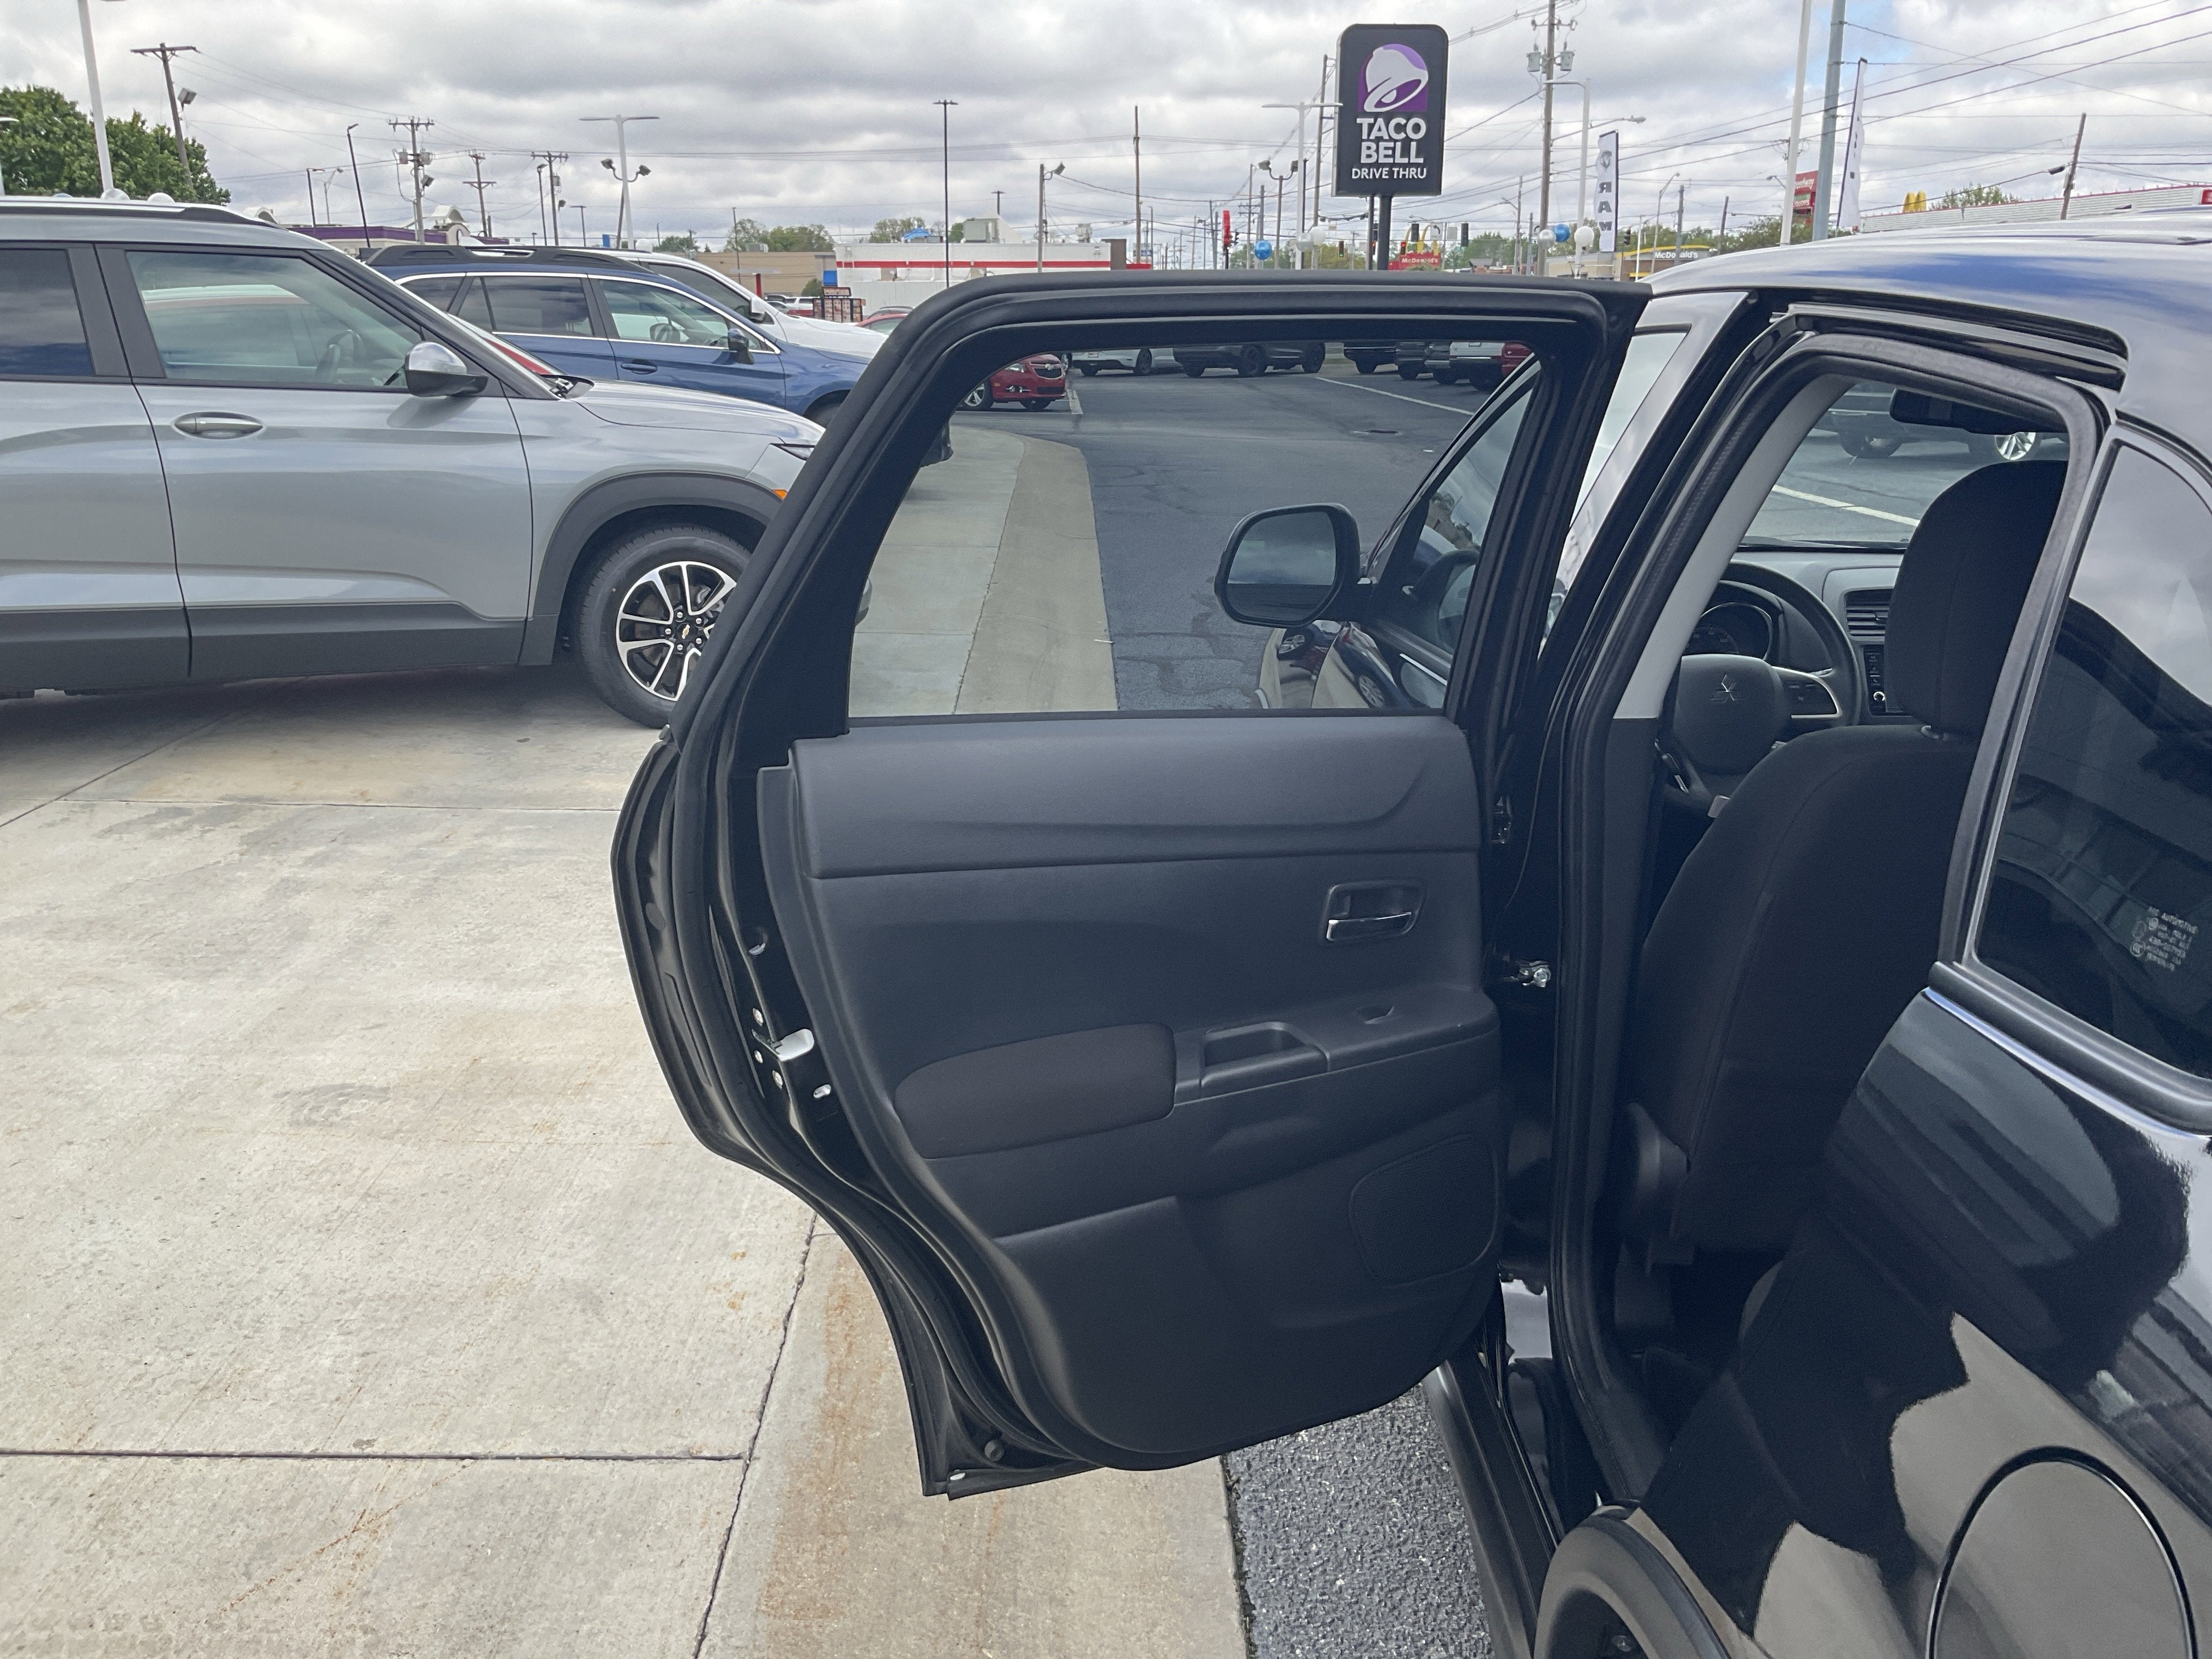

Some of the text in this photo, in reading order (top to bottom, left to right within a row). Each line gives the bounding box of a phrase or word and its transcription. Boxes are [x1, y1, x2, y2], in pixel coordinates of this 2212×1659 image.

[1356, 117, 1426, 140] TACO
[1360, 141, 1424, 163] BELL
[1351, 167, 1426, 179] DRIVE THRU
